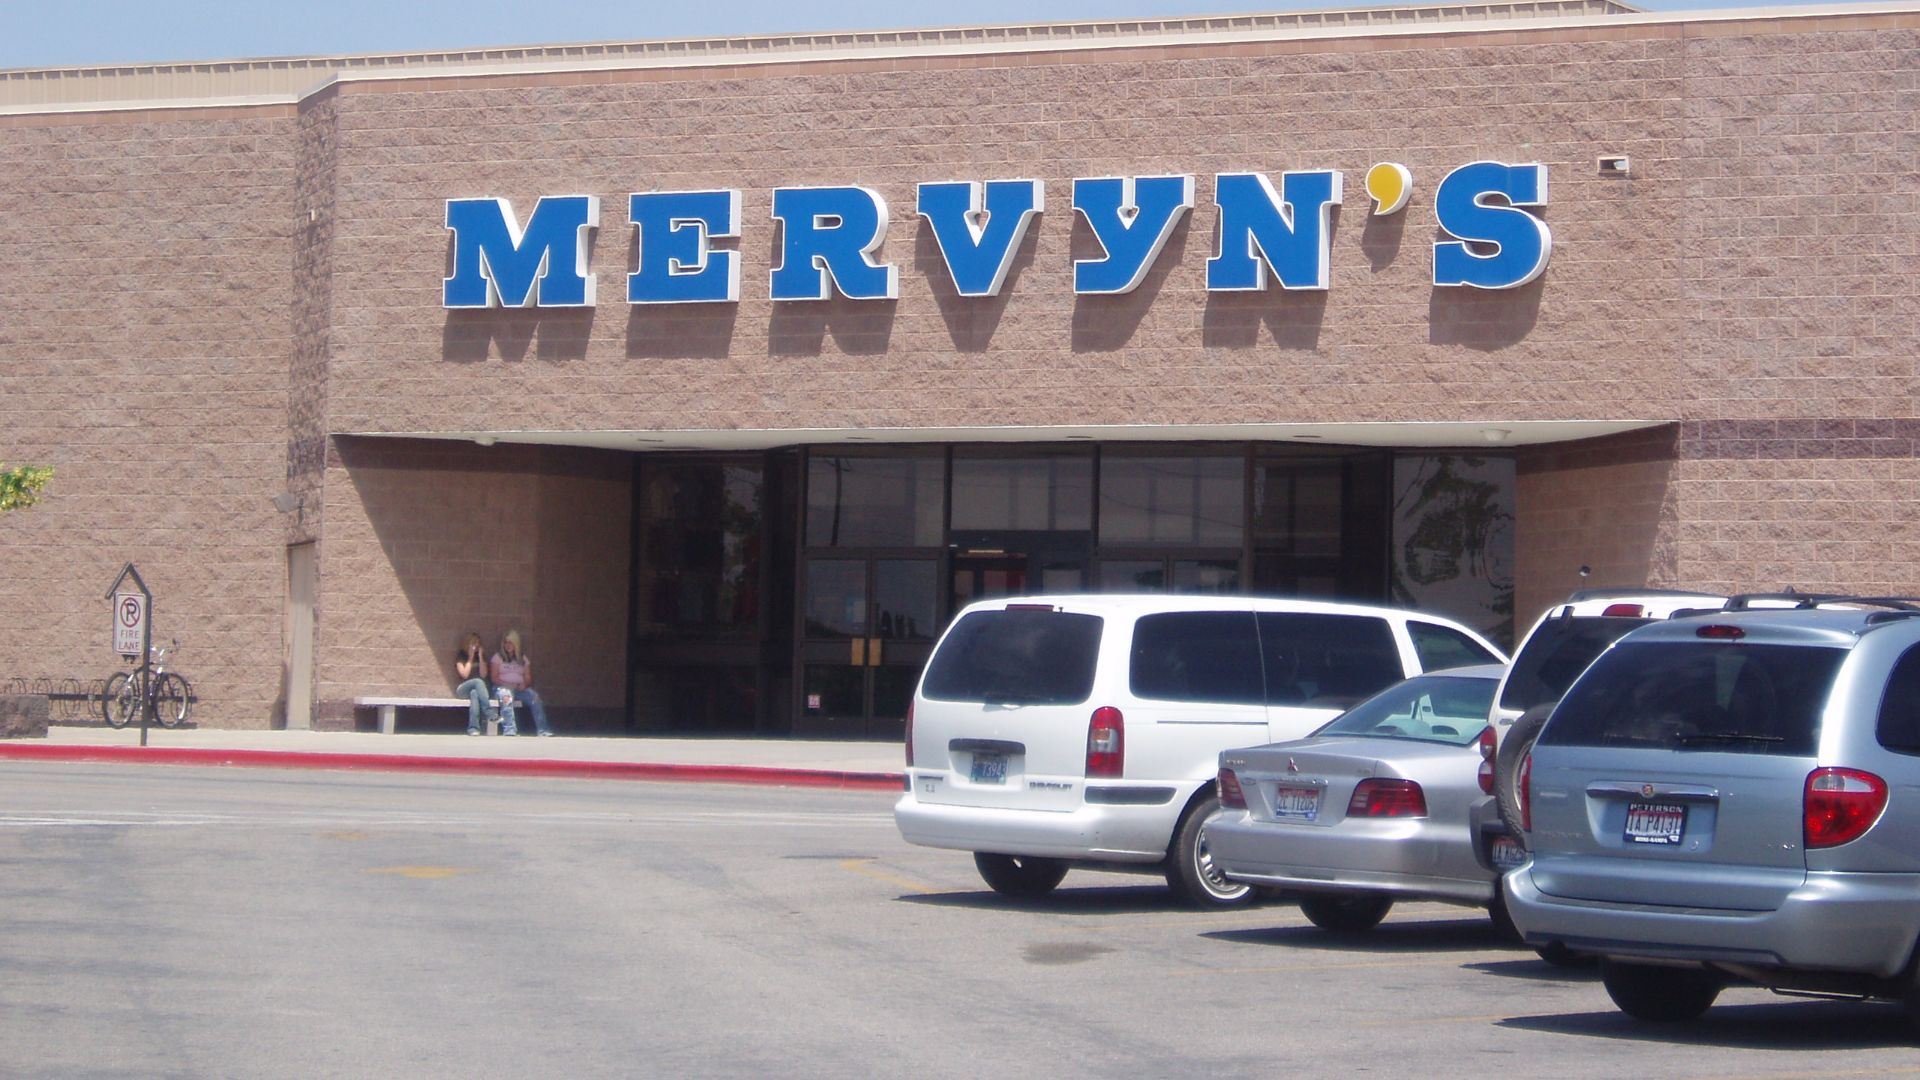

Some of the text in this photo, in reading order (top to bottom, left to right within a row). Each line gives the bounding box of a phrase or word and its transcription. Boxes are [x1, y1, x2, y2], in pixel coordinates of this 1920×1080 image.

[443, 159, 1551, 310] MERVYN'S
[120, 629, 140, 639] FIRE
[119, 641, 140, 651] LANE
[1630, 803, 1683, 813] PETERSON
